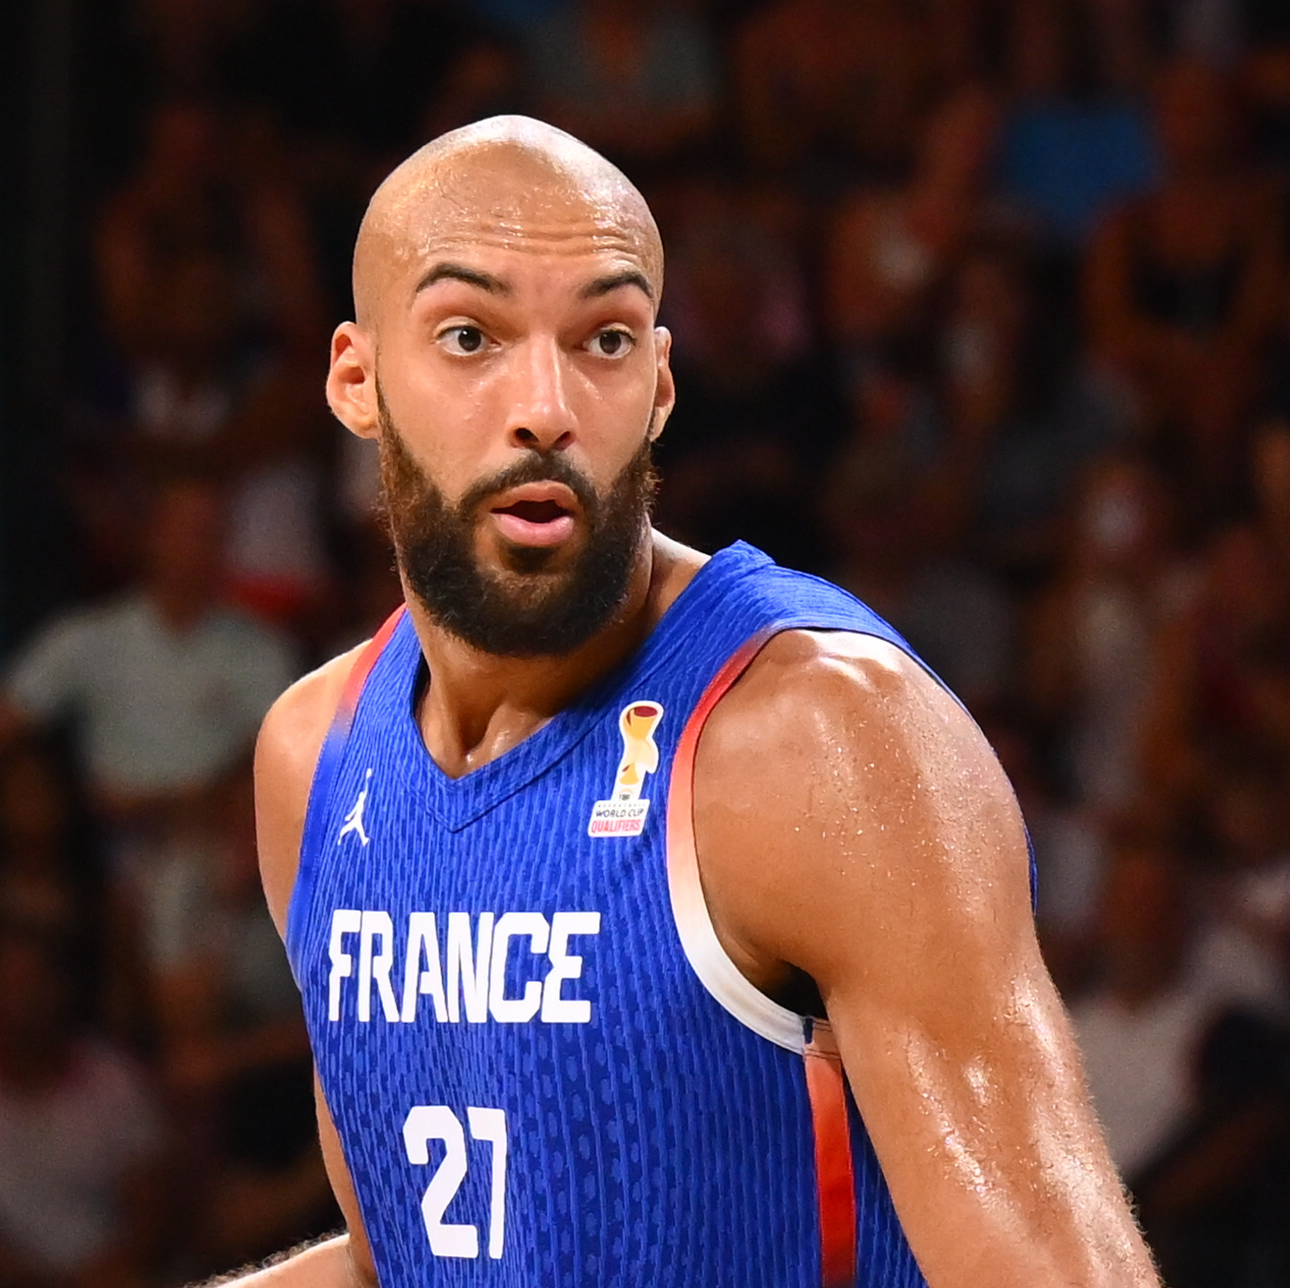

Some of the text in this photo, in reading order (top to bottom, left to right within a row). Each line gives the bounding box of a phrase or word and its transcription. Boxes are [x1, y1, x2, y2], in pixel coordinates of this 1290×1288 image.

[591, 819, 641, 833] QUALIFIERS
[596, 808, 644, 818] WORLD CUP
[328, 909, 601, 1023] FRANCE
[402, 1105, 507, 1259] 27
